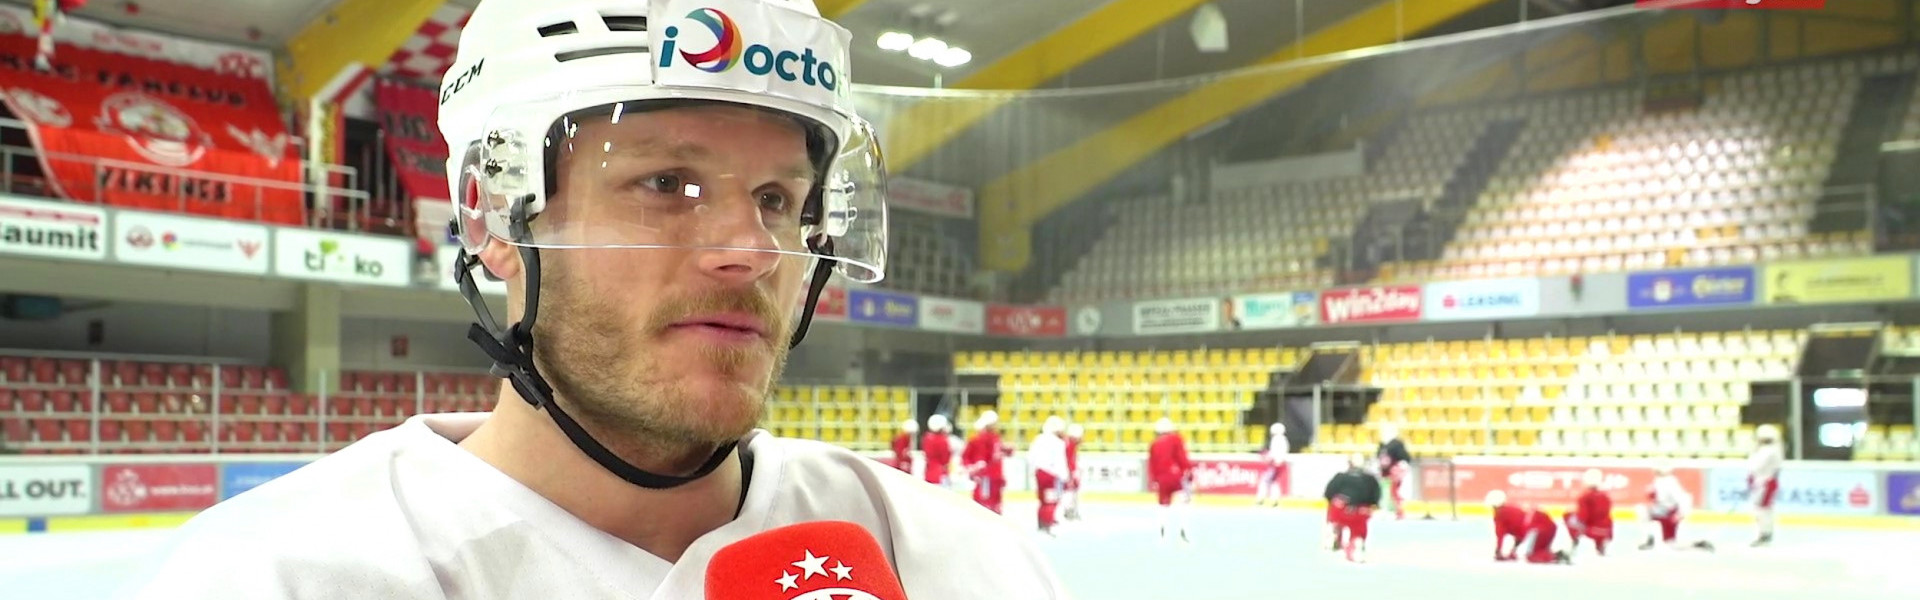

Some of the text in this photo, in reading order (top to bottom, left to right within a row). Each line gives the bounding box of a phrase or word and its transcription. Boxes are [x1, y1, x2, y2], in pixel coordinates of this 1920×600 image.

[440, 57, 485, 105] CCM
[0, 224, 98, 251] aumit
[1324, 287, 1420, 324] win2day
